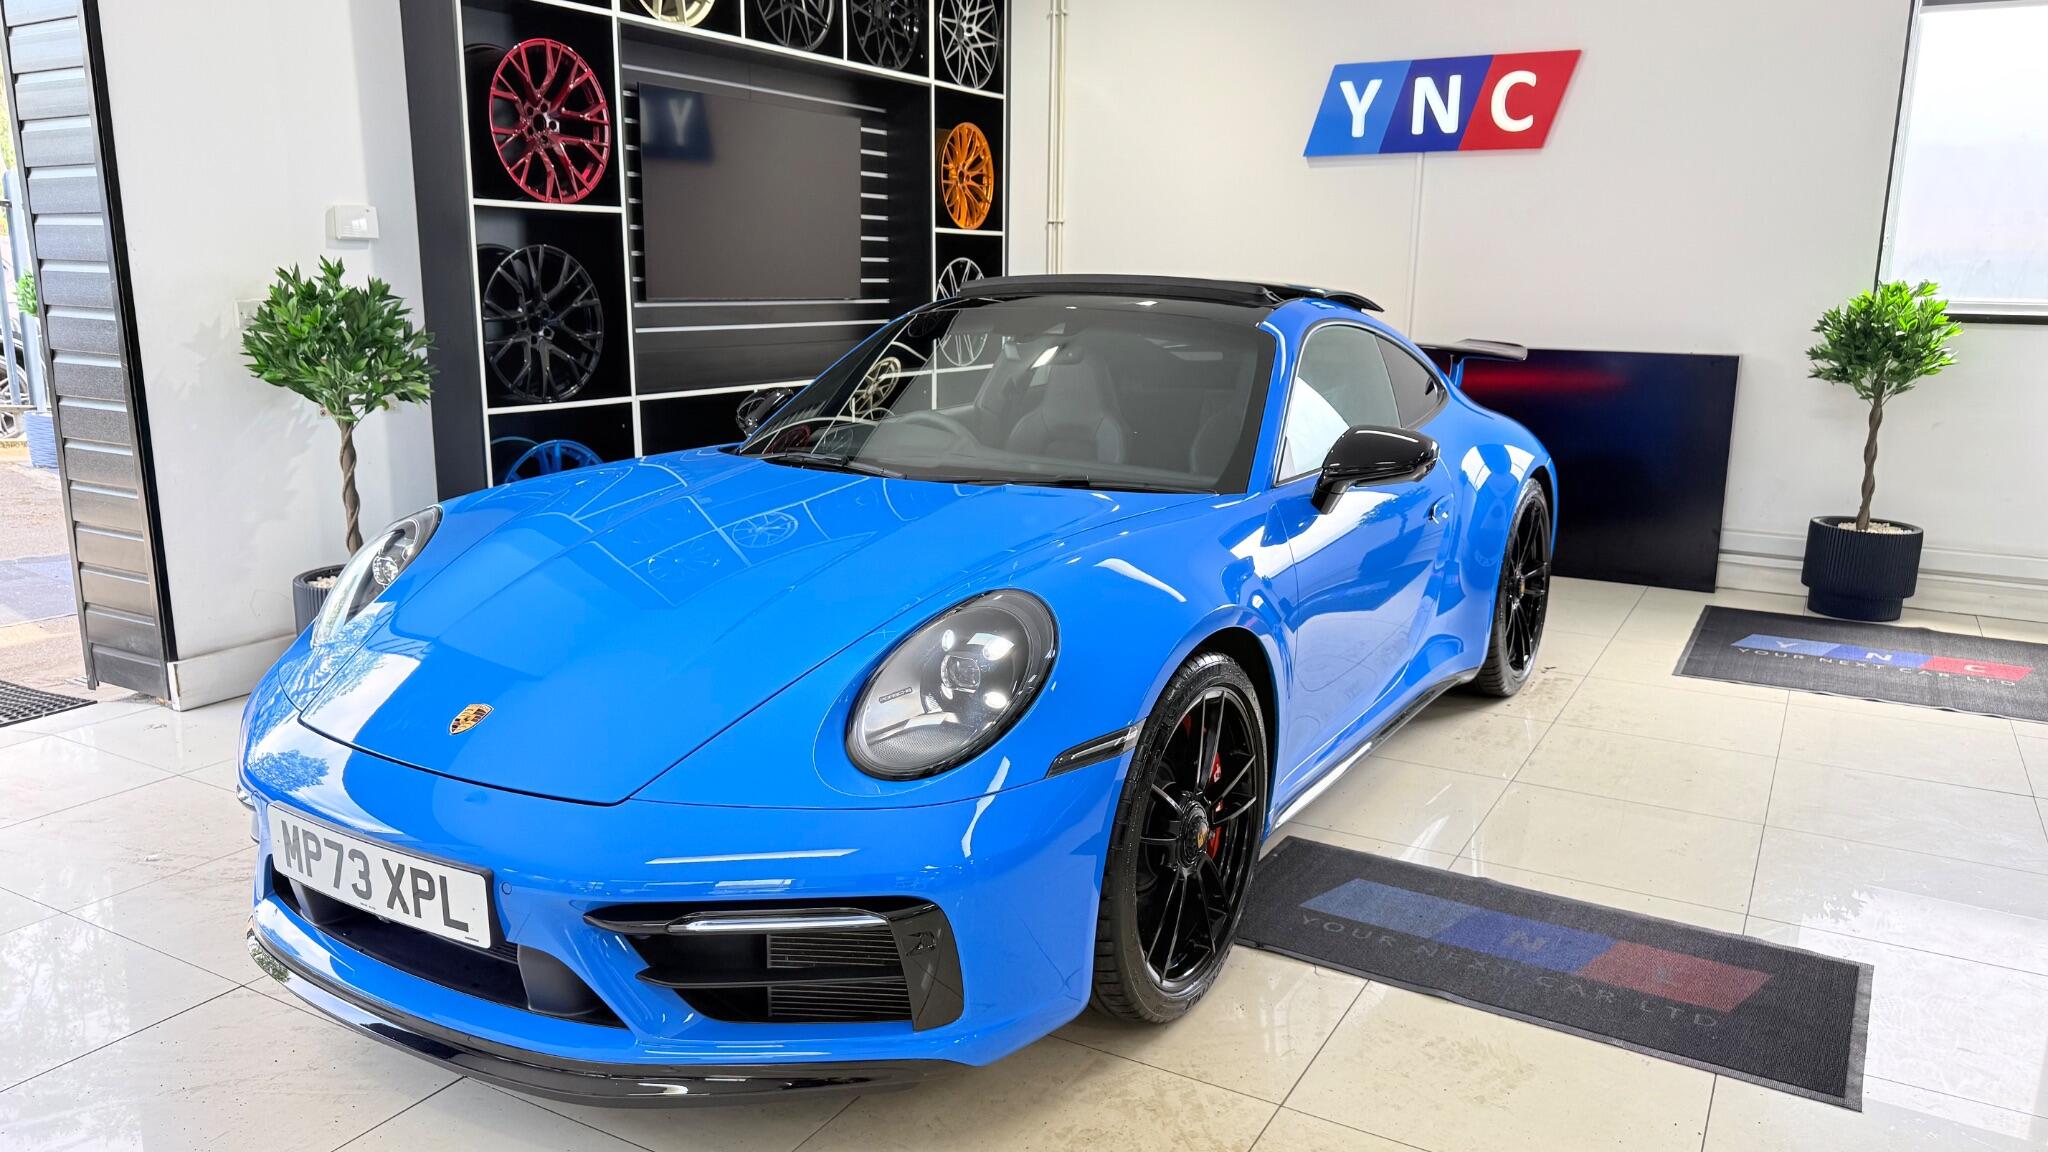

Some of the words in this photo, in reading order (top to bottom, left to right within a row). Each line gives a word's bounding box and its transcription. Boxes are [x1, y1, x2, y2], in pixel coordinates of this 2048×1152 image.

[1340, 70, 1537, 138] YNC
[1738, 647, 1804, 660] YOUR
[1819, 657, 1885, 670] NEXT
[1899, 667, 1950, 678] CAR
[1967, 675, 2016, 687] LTD
[281, 819, 373, 901] MP73
[382, 858, 470, 933] XPL
[1302, 914, 1396, 948] YOUR
[1536, 975, 1615, 1004] CAR
[1640, 1000, 1718, 1028] LTD
